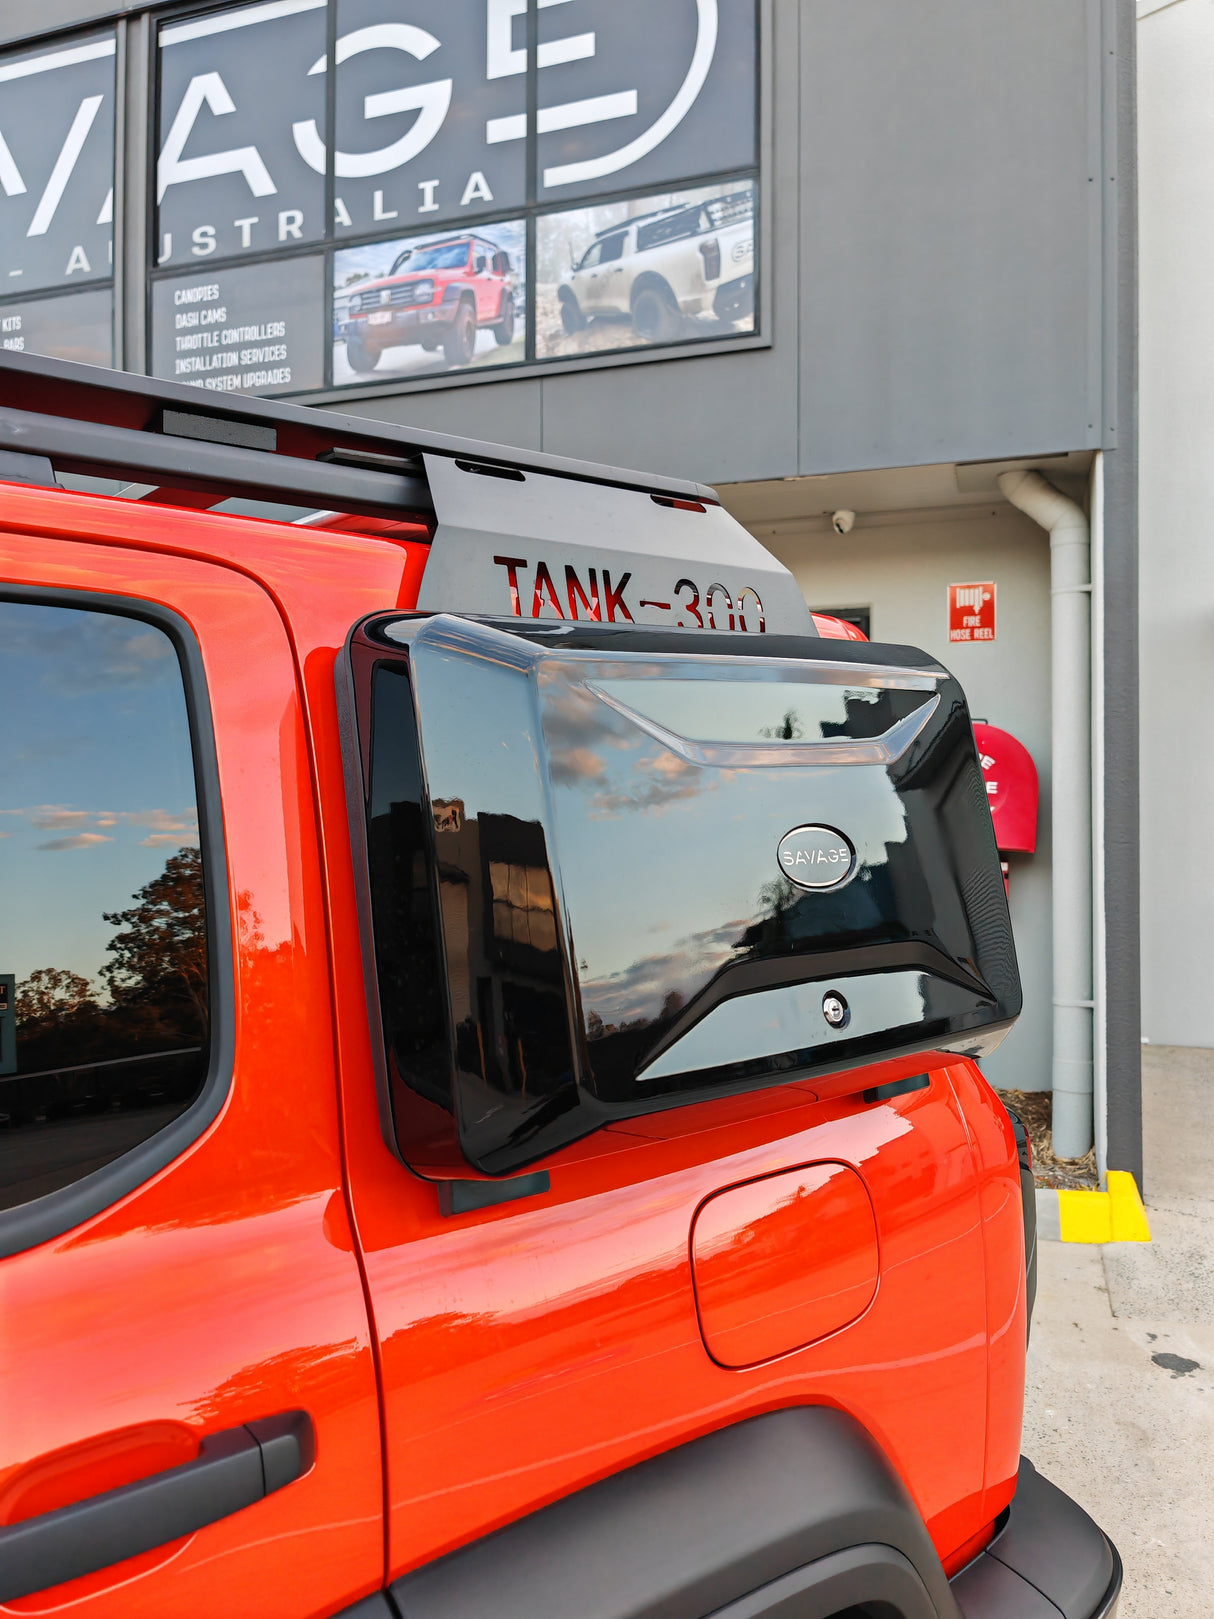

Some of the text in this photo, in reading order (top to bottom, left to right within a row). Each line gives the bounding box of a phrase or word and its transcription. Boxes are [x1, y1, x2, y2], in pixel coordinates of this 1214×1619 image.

[174, 284, 219, 305] CANOPIES
[2, 316, 21, 332] KITS
[175, 307, 227, 329] DASH CAMS
[175, 321, 286, 352] THROTTLE CONTROLLERS
[175, 344, 287, 374] INSTALLATION SERVICES
[205, 374, 242, 391] SYSTEM
[243, 367, 291, 388] UPGRADES
[963, 615, 981, 627] FIRE
[950, 627, 993, 641] HOSE REEL
[783, 848, 849, 866] SAVAGE
